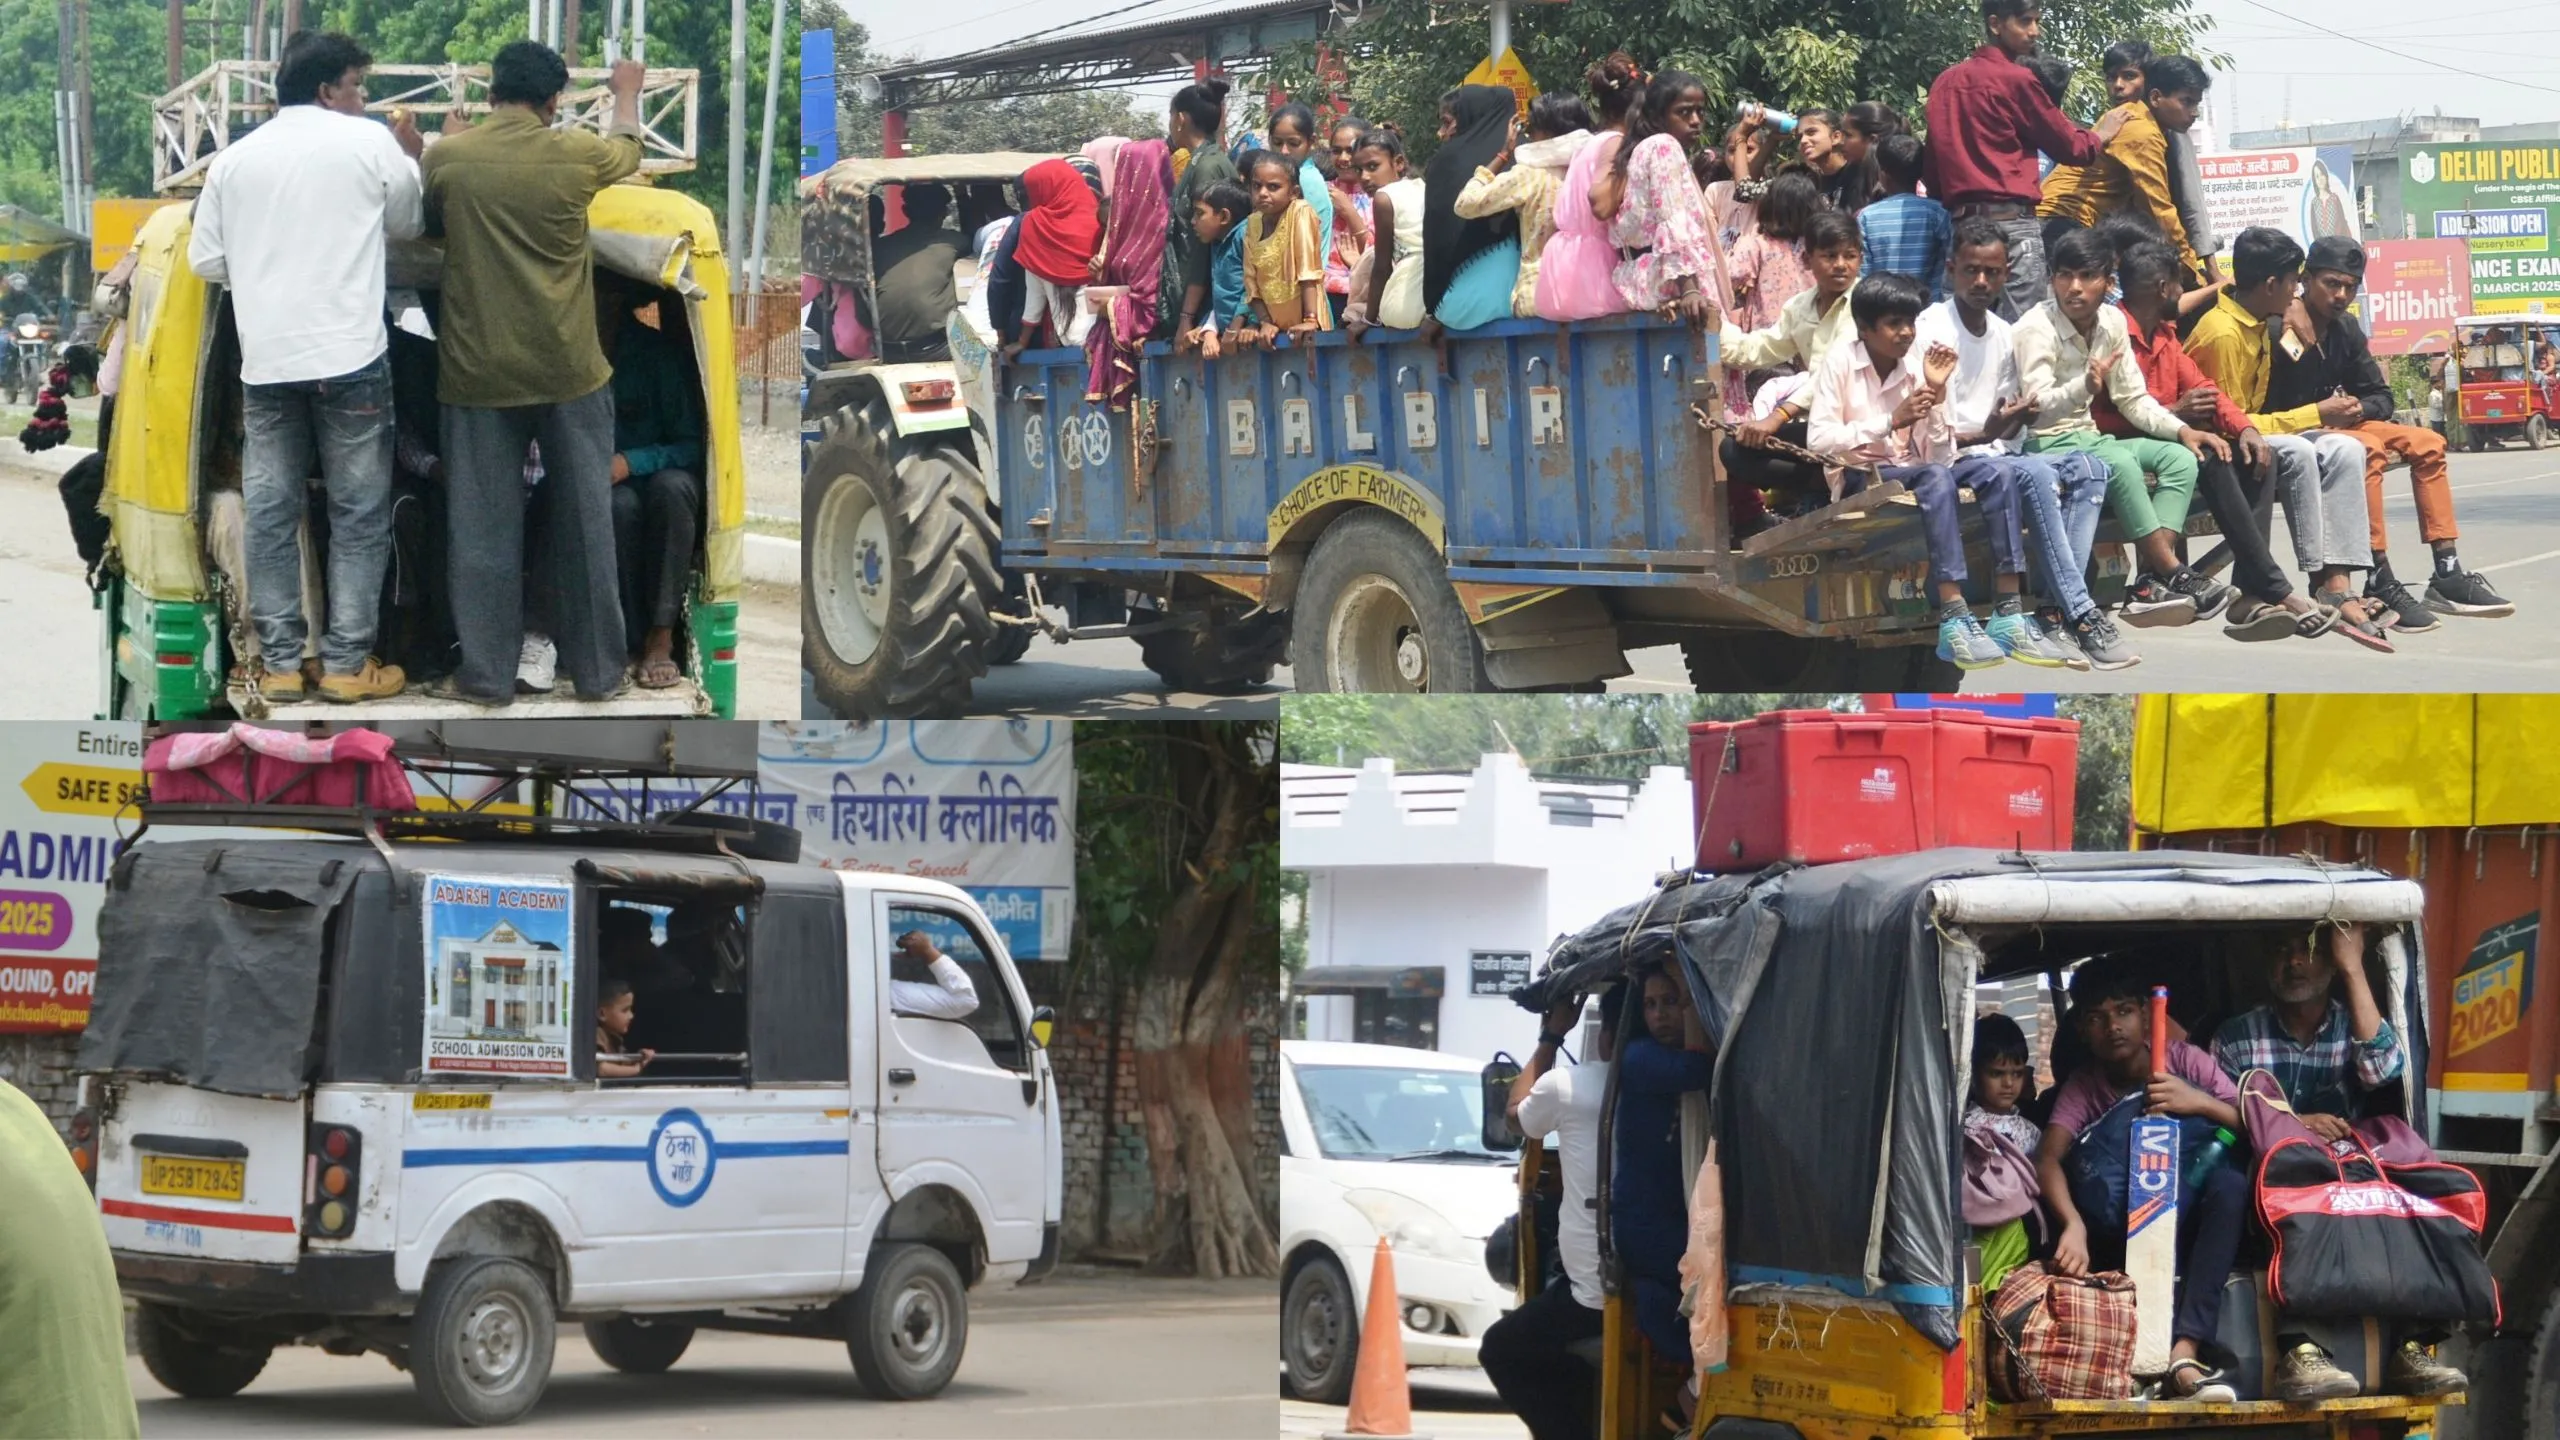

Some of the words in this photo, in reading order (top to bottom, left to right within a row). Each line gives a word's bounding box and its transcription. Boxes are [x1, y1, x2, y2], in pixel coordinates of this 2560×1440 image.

[2440, 151, 2496, 182] DELHI
[2501, 184, 2514, 192] the
[2537, 182, 2546, 190] of
[2510, 195, 2534, 204] CBSE
[2511, 213, 2542, 234] OPEN
[2505, 240, 2515, 248] to
[2483, 283, 2530, 294] MARCH
[2531, 280, 2560, 291] 2025
[1279, 478, 1325, 527] CHOICE
[1329, 469, 1350, 495] OF
[1357, 470, 1422, 526] FARMER
[57, 776, 110, 804] SAFE
[938, 769, 1059, 844] क्लीनिक
[906, 858, 969, 878] Speech
[434, 884, 490, 906] ADARSH
[497, 890, 567, 911] ACADEMY
[0, 900, 55, 936] 2025
[2455, 958, 2515, 1005] GIFT
[2450, 988, 2517, 1050] 2020
[431, 1040, 473, 1056] SCHOOL
[477, 1044, 535, 1058] ADMISSION
[537, 1046, 565, 1059] OPEN
